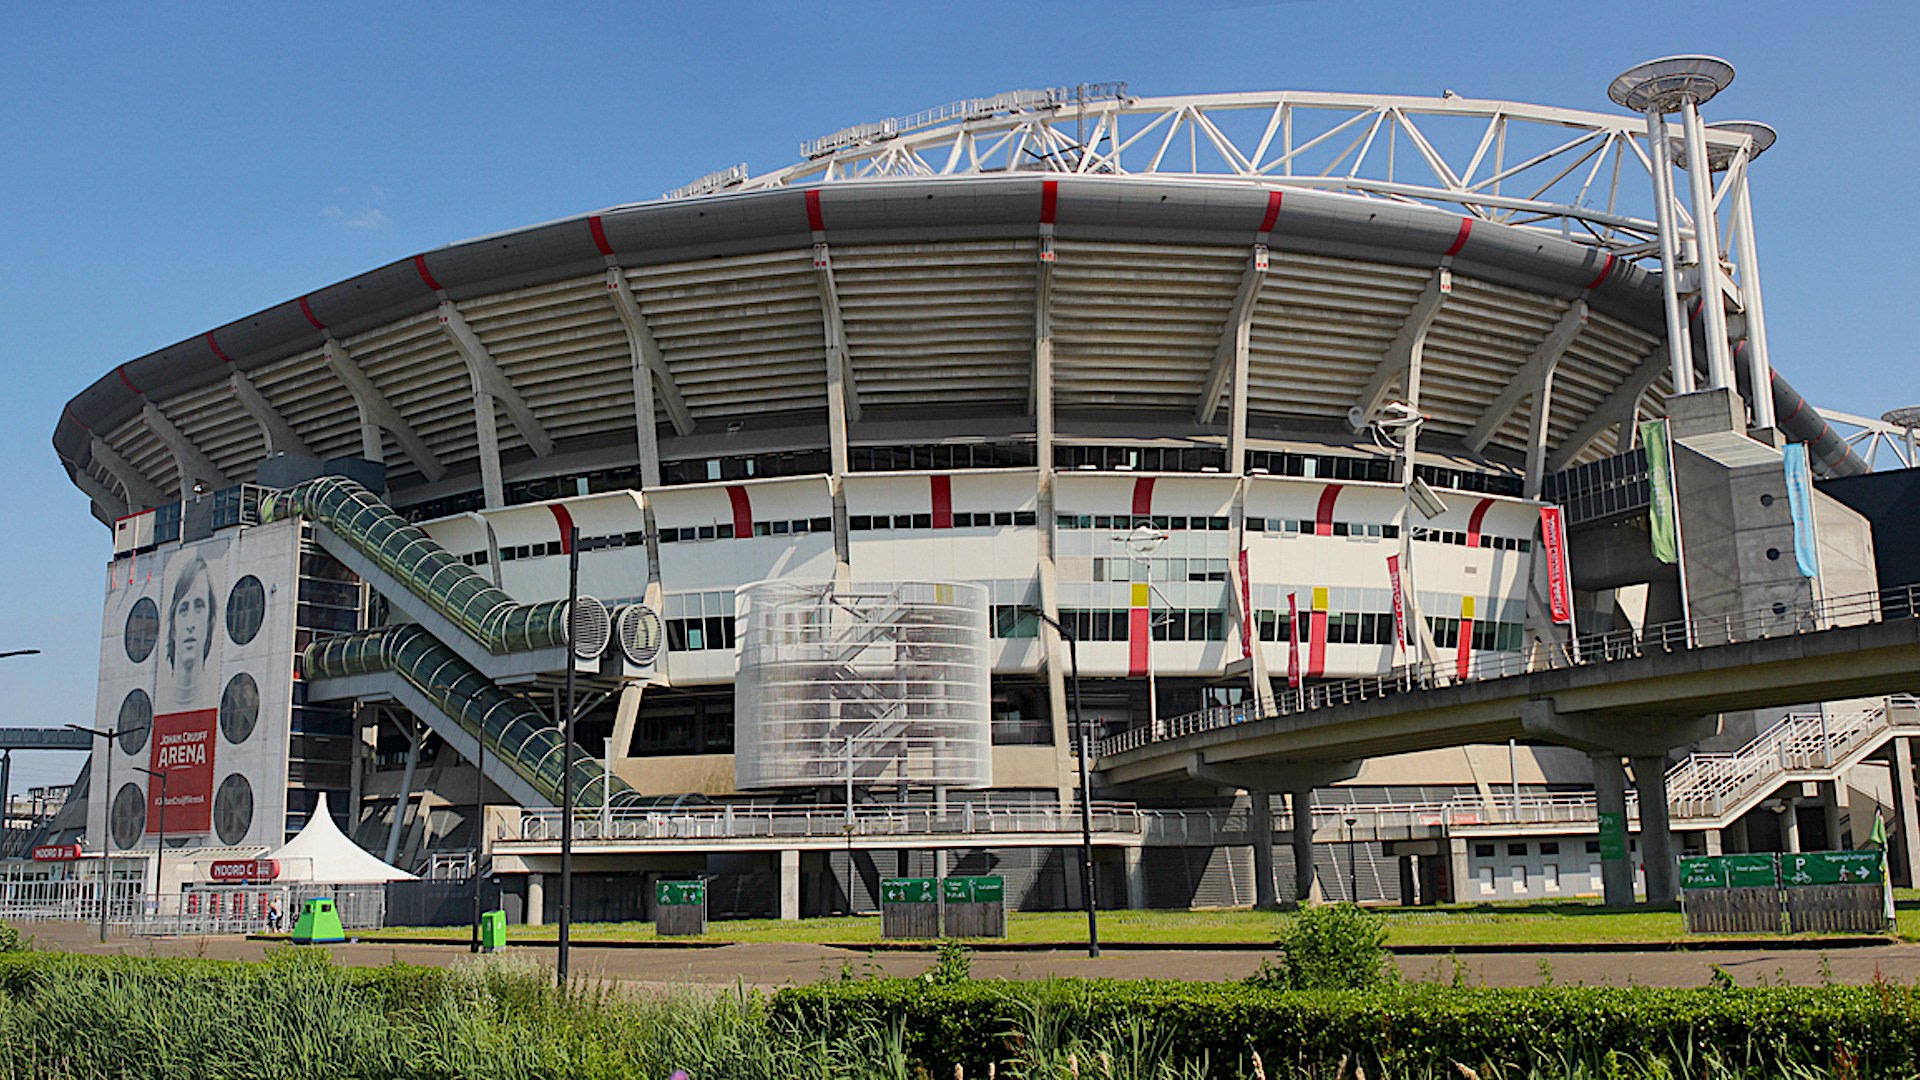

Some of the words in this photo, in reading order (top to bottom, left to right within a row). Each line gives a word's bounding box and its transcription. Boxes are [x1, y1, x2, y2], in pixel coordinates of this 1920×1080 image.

[160, 734, 182, 745] JOHAN
[157, 743, 206, 769] ARENA
[214, 864, 246, 877] NOORD
[247, 863, 253, 876] C
[1796, 858, 1806, 871] P
